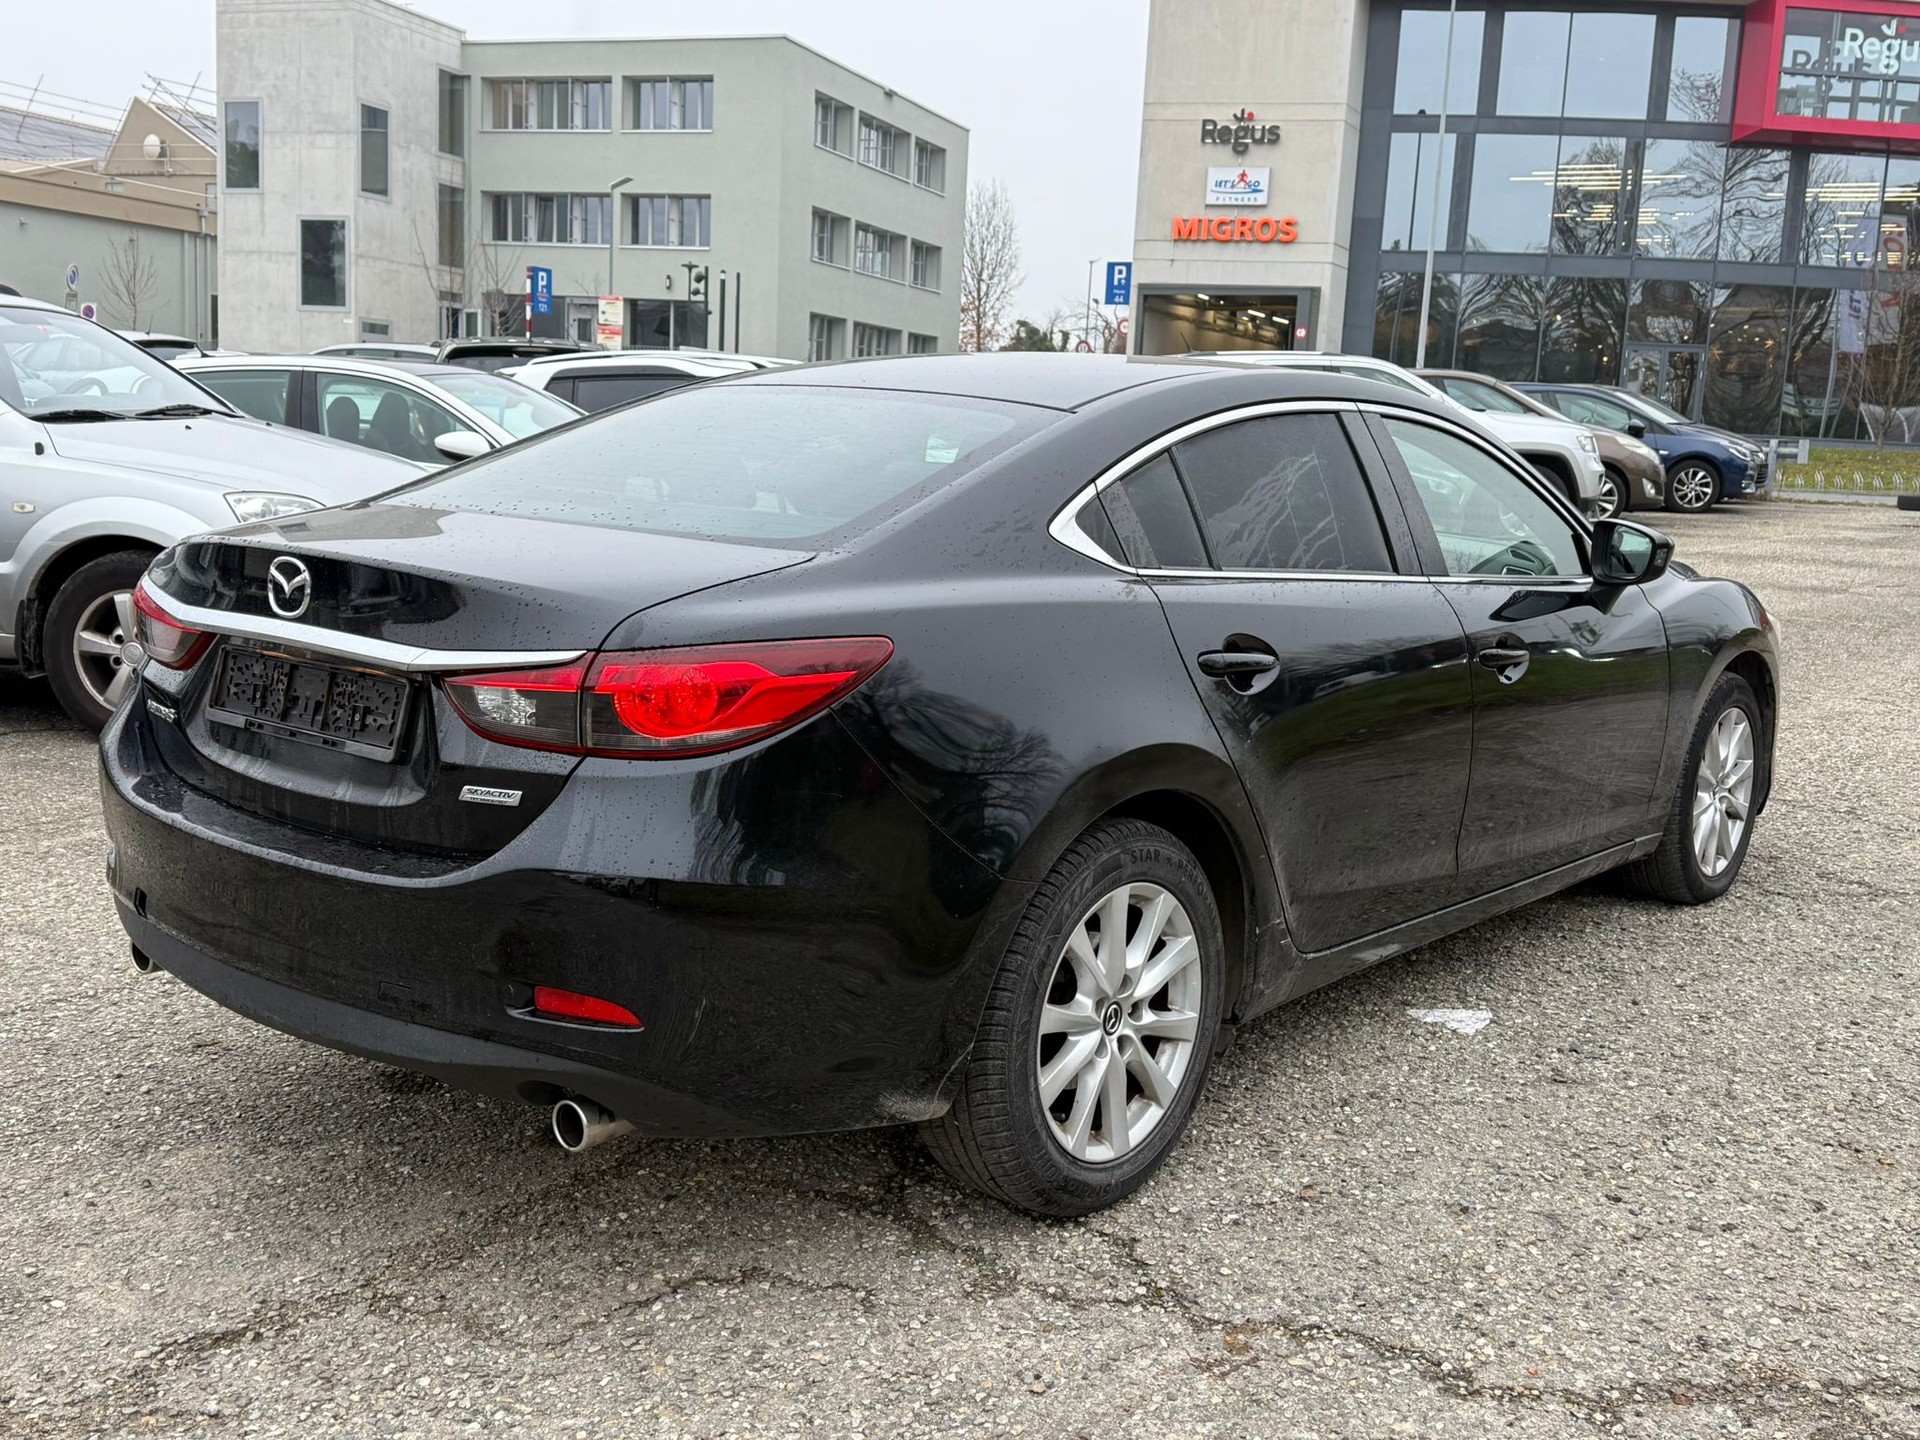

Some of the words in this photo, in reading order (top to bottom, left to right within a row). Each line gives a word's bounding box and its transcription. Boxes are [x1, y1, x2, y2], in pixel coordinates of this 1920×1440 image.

[1843, 25, 1920, 76] Regu
[1201, 117, 1281, 154] Regus
[1173, 216, 1298, 242] MIGROS
[538, 271, 547, 292] P
[1113, 265, 1126, 286] P
[466, 788, 516, 799] SKYACTIV
[1130, 848, 1161, 865] STAR
